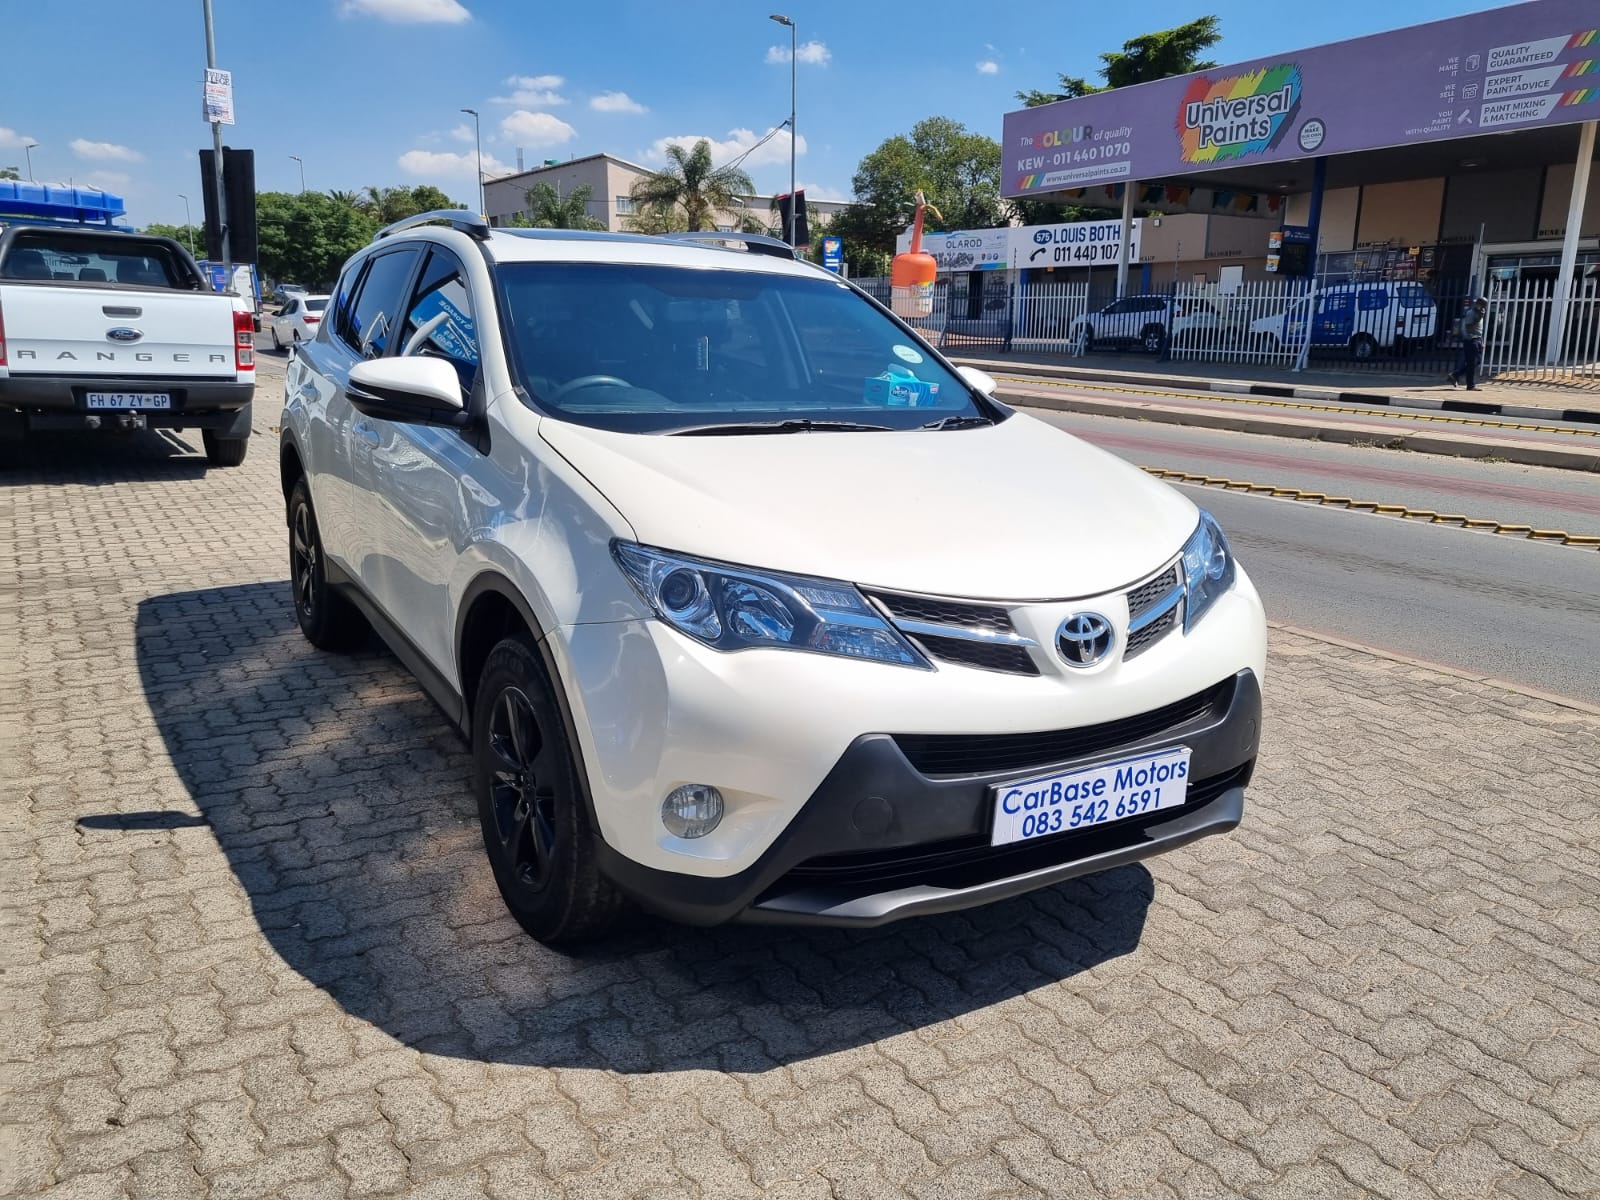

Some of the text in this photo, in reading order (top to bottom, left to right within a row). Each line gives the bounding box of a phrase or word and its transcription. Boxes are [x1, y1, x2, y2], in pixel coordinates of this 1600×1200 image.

[1448, 56, 1459, 64] WE
[1490, 51, 1554, 68] GUARANTEED
[1491, 46, 1530, 60] QUALITY
[1438, 63, 1459, 73] MAKE
[1486, 79, 1551, 97] PAINT ADVICE
[1487, 74, 1524, 87] EXPERT
[1439, 91, 1455, 99] SELL
[1187, 86, 1291, 126] Universal
[1484, 99, 1547, 114] PAINT MIXING
[1432, 117, 1452, 125] PAINT
[1438, 110, 1453, 118] YOU
[1490, 109, 1539, 123] MATCHING
[1020, 125, 1132, 150] The COLOUR of quality
[1200, 118, 1270, 147] Paints
[1405, 124, 1452, 136] WITH QUALITY
[1017, 156, 1045, 171] KEW
[1053, 151, 1071, 166] 011
[1073, 147, 1097, 162] 440
[1100, 142, 1130, 159] 1070
[1046, 166, 1127, 182] www.universalpaints.co.za
[1036, 232, 1051, 243] 575
[1053, 227, 1086, 244] LOUIS
[1054, 246, 1072, 263] 011
[1074, 244, 1098, 261] 440
[17, 350, 226, 363] RANGER
[90, 394, 168, 408] FH 67 ZY GP
[1002, 760, 1187, 815] CarBase Motors
[1022, 788, 1161, 838] 083 542 6591
